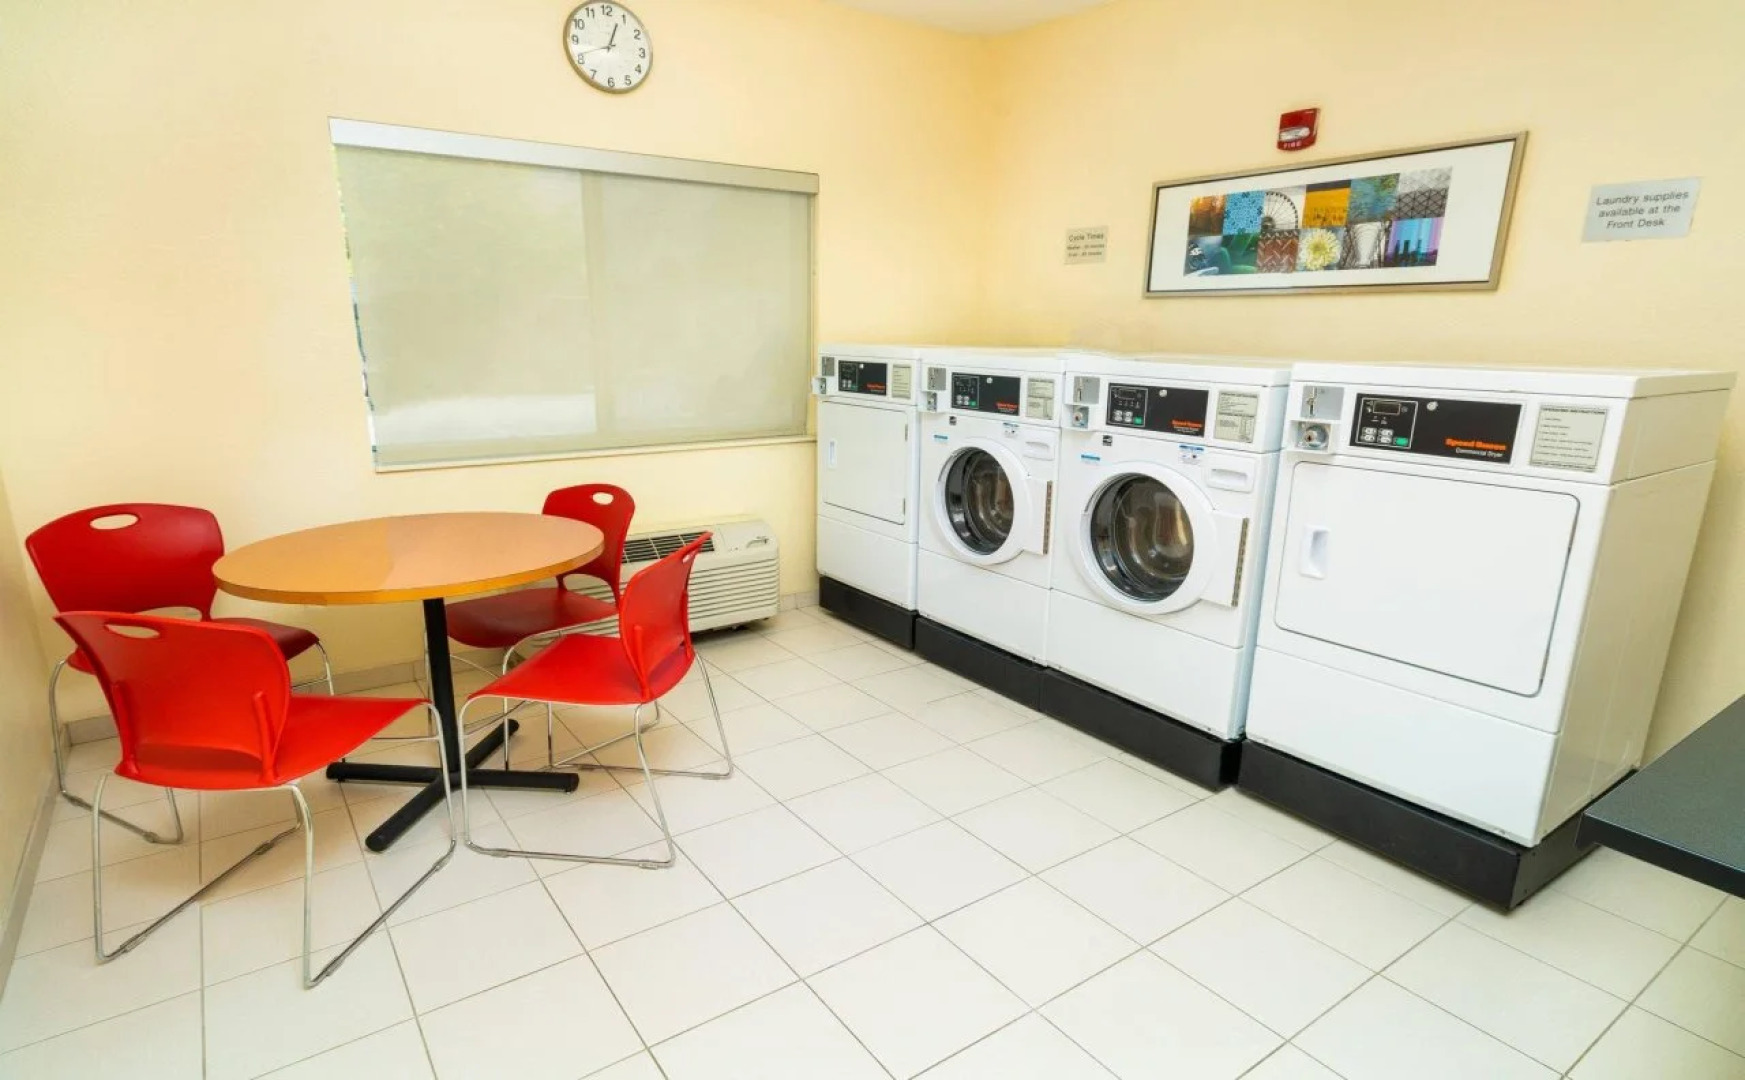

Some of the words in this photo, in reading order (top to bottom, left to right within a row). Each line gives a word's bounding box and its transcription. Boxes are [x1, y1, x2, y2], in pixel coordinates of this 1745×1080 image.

[585, 7, 595, 19] 11
[601, 4, 613, 17] 12
[573, 18, 585, 30] 10
[622, 14, 627, 24] 1
[572, 35, 579, 45] 9
[634, 29, 641, 40] 2
[639, 47, 646, 59] 3
[577, 53, 585, 65] 8
[590, 69, 597, 80] 7
[634, 64, 641, 74] 4
[608, 77, 615, 88] 6
[624, 75, 632, 86] 5
[1283, 141, 1302, 149] FIRE
[1596, 195, 1639, 206] Laundry
[1643, 191, 1689, 203] supplies
[1598, 206, 1644, 217] available
[1648, 206, 1659, 214] at
[1662, 204, 1681, 214] the
[1606, 219, 1634, 229] Front
[1637, 218, 1664, 228] Desk
